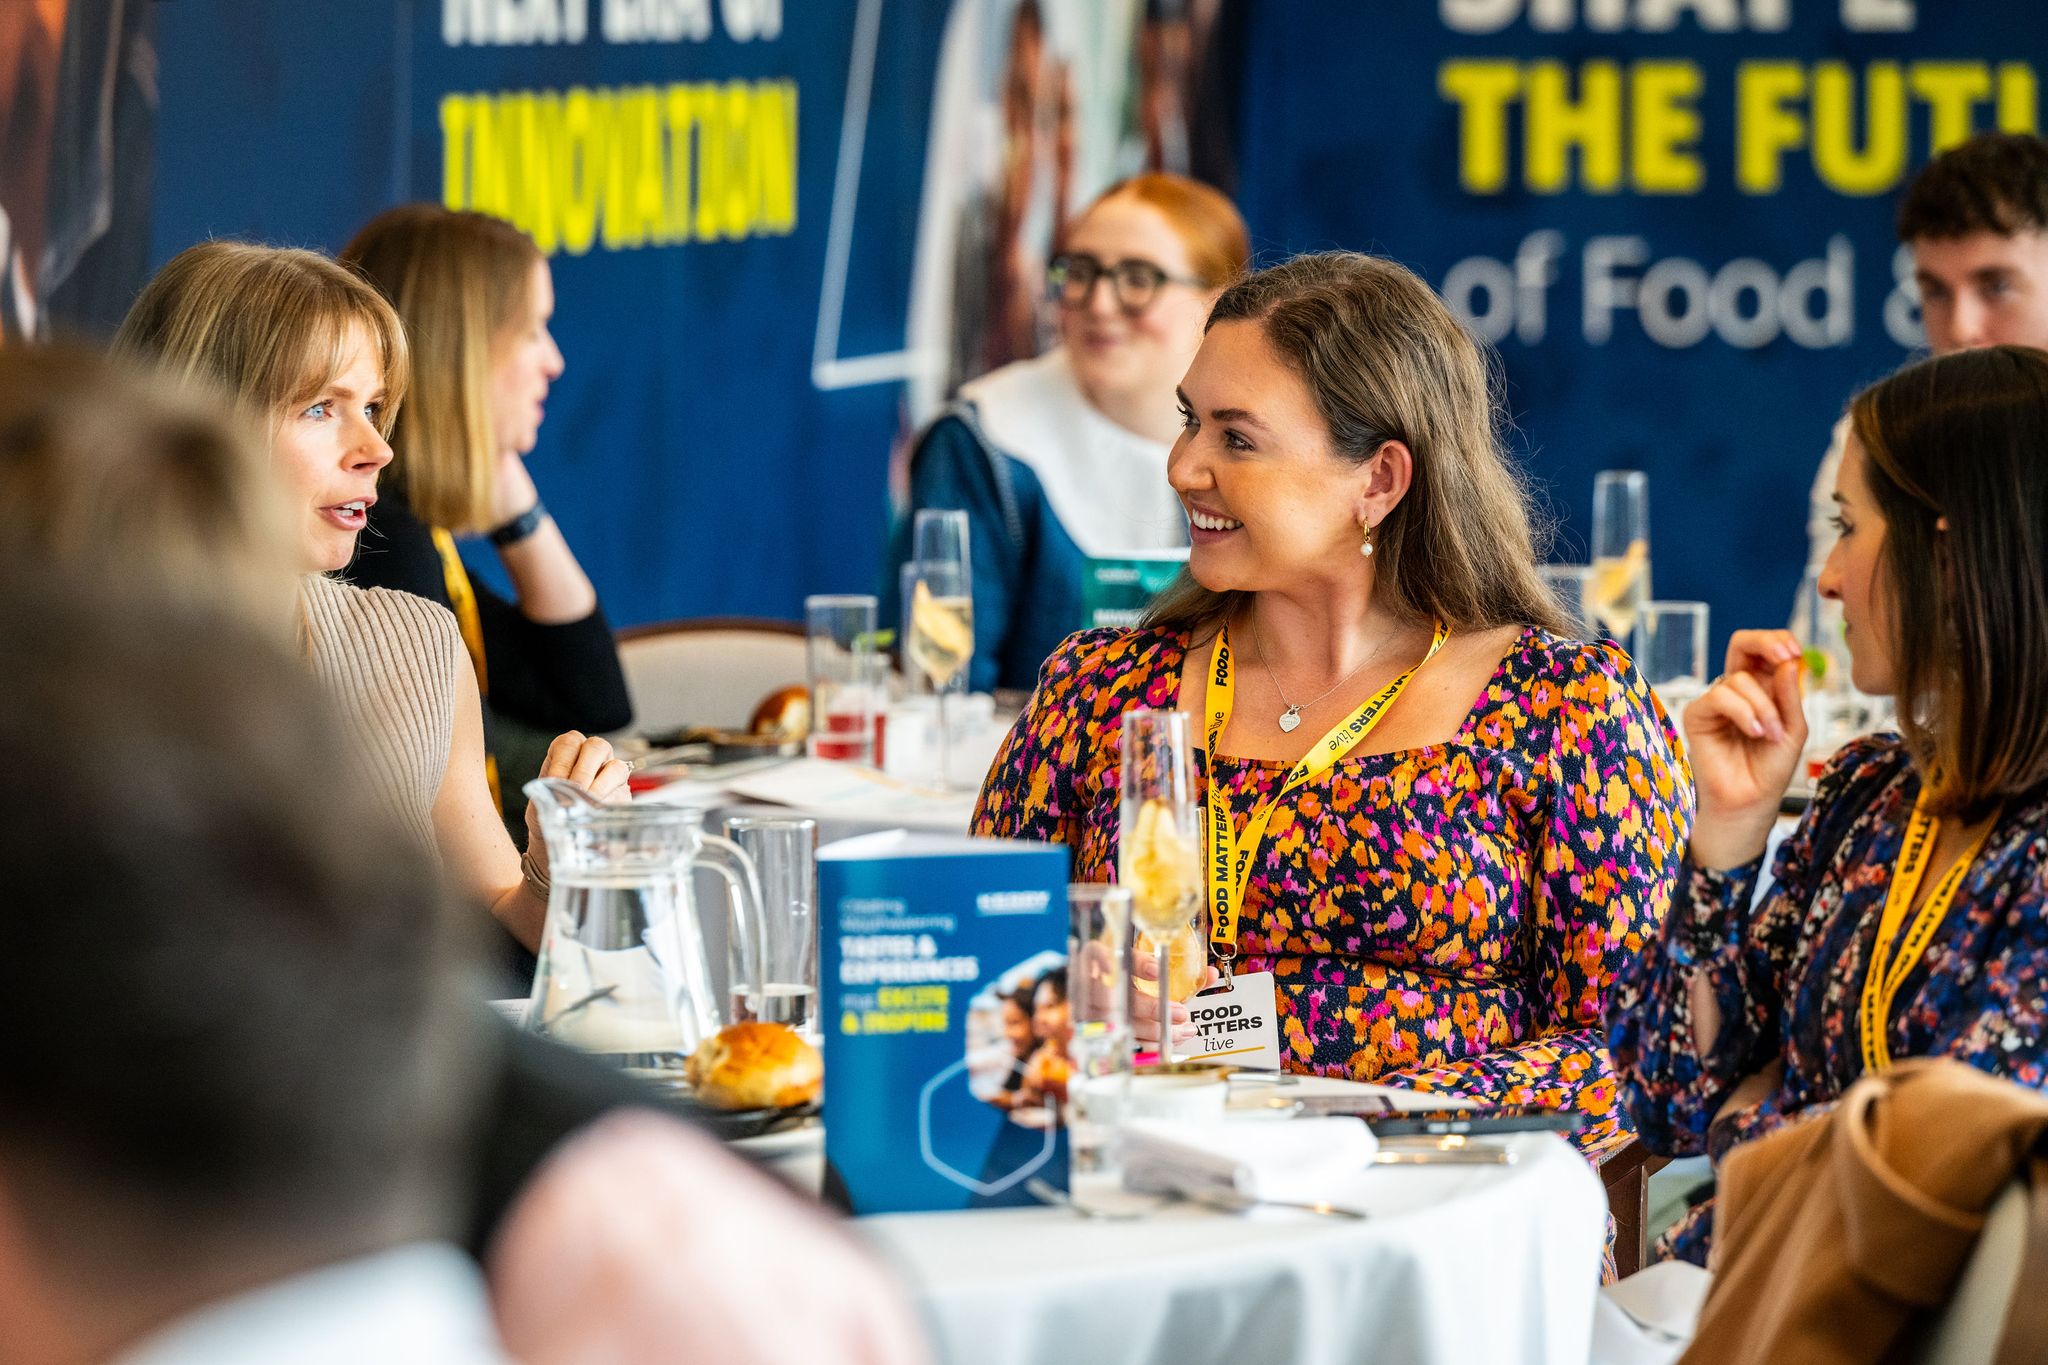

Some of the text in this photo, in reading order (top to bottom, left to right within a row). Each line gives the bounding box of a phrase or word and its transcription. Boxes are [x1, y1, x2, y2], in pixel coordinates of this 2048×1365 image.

[1438, 58, 1703, 195] THE
[440, 78, 797, 257] INNOVATION
[1440, 229, 1566, 347] of
[1580, 232, 1854, 350] Food
[1215, 647, 1230, 687] FOOD
[1349, 673, 1409, 734] MATTERS
[1328, 728, 1355, 751] live
[1214, 804, 1228, 881] MATTERS
[1216, 887, 1230, 938] FOOD
[1190, 1005, 1243, 1023] FOOD
[1195, 1016, 1263, 1037] ATTERS
[1203, 1037, 1234, 1052] live
